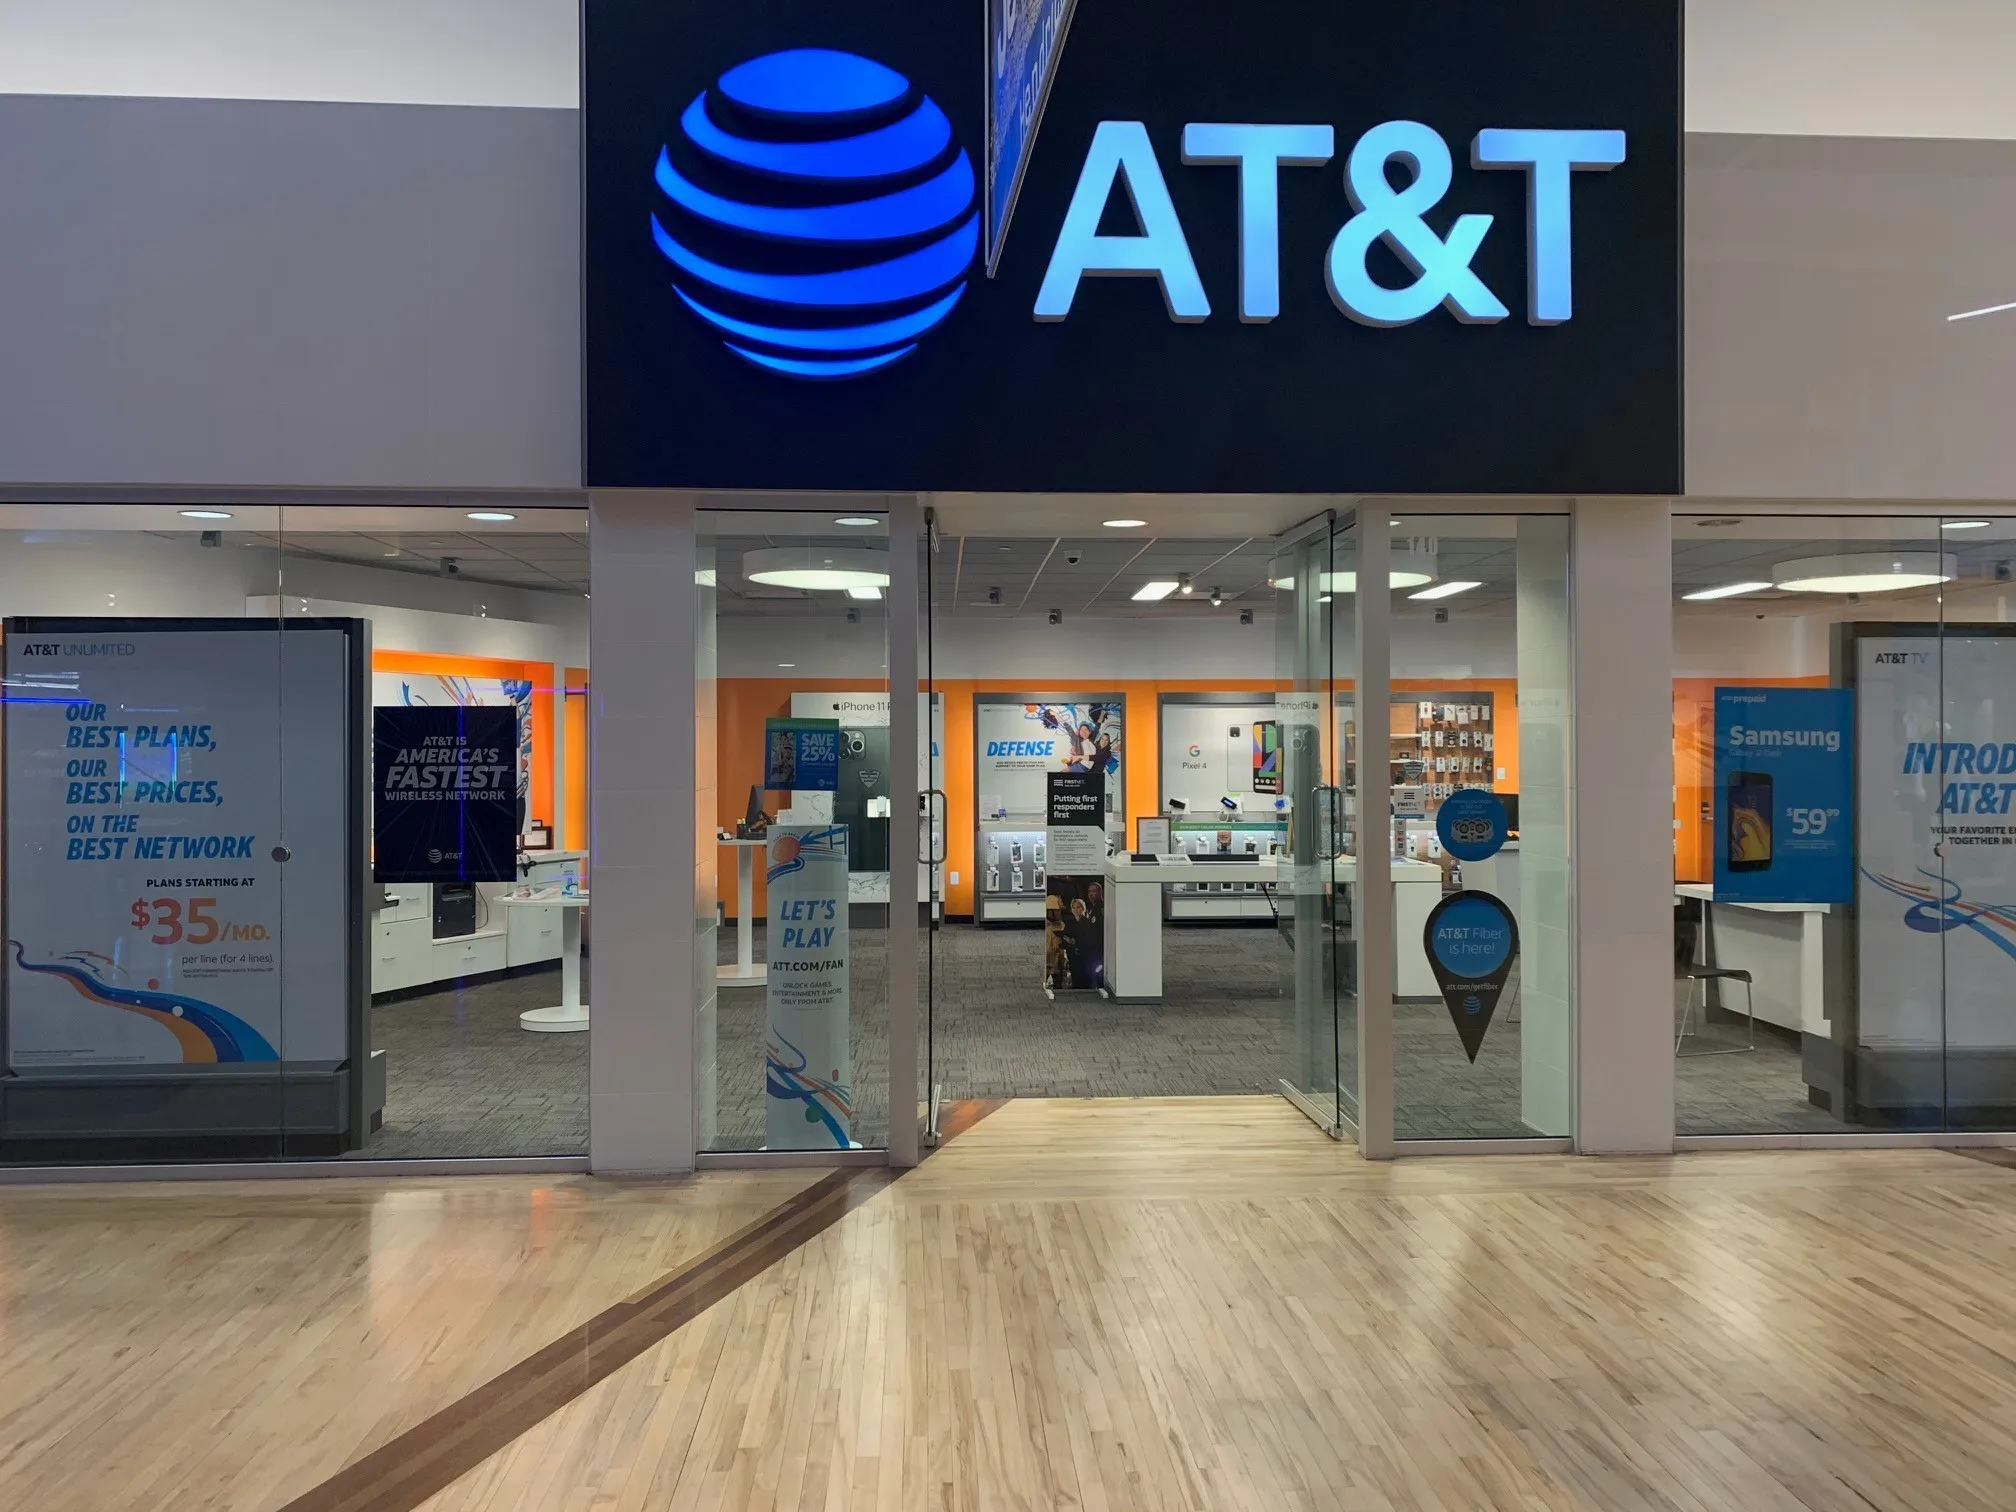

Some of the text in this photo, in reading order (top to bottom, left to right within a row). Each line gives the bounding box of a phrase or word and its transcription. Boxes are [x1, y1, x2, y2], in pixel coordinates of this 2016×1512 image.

[1033, 119, 1627, 328] AT&T
[23, 643, 135, 656] AT&T UNLIMITED
[1875, 653, 1928, 664] AT&T TV
[1733, 694, 1767, 704] prepaid
[66, 703, 106, 722] OUR
[841, 702, 875, 711] iPhone
[877, 702, 886, 711] 11
[66, 725, 217, 752] BEST PLANS,
[423, 736, 467, 746] AT&T IS
[801, 734, 835, 746] SAVE
[1730, 725, 1840, 752] Samsung
[801, 746, 836, 762] 25%
[986, 741, 1055, 757] DEFENSE
[395, 748, 500, 764] AMERICA'S
[1903, 742, 2016, 775] INTROD
[66, 759, 107, 777] OUR
[1182, 761, 1199, 769] Pixel
[386, 765, 508, 789] FASTEST
[66, 780, 224, 807] BEST PRICES,
[385, 790, 506, 801] WIRELESS NETWORK
[1053, 794, 1098, 803] Putting first
[1936, 782, 2016, 814] AT&T
[1053, 803, 1095, 812] responders
[1053, 811, 1070, 819] first
[66, 814, 139, 834] ON THE
[1960, 826, 2006, 834] FAVORITE
[1949, 837, 1999, 845] TOGETHER
[2002, 837, 2012, 845] IN
[66, 836, 256, 861] BEST NETWORK
[444, 852, 462, 860] AT&T
[146, 877, 256, 888] PLANS STARTING AT
[780, 899, 836, 921] LET'S
[783, 926, 835, 948] PLAY
[1438, 927, 1504, 939] AT&T Fiber
[1449, 942, 1495, 955] is here!
[182, 956, 198, 966] per
[201, 954, 218, 964] line
[220, 954, 237, 964] (for
[239, 954, 246, 963] 4
[773, 959, 844, 972] ATT.COM/FAN
[772, 989, 820, 997] ENTERTAINMENT
